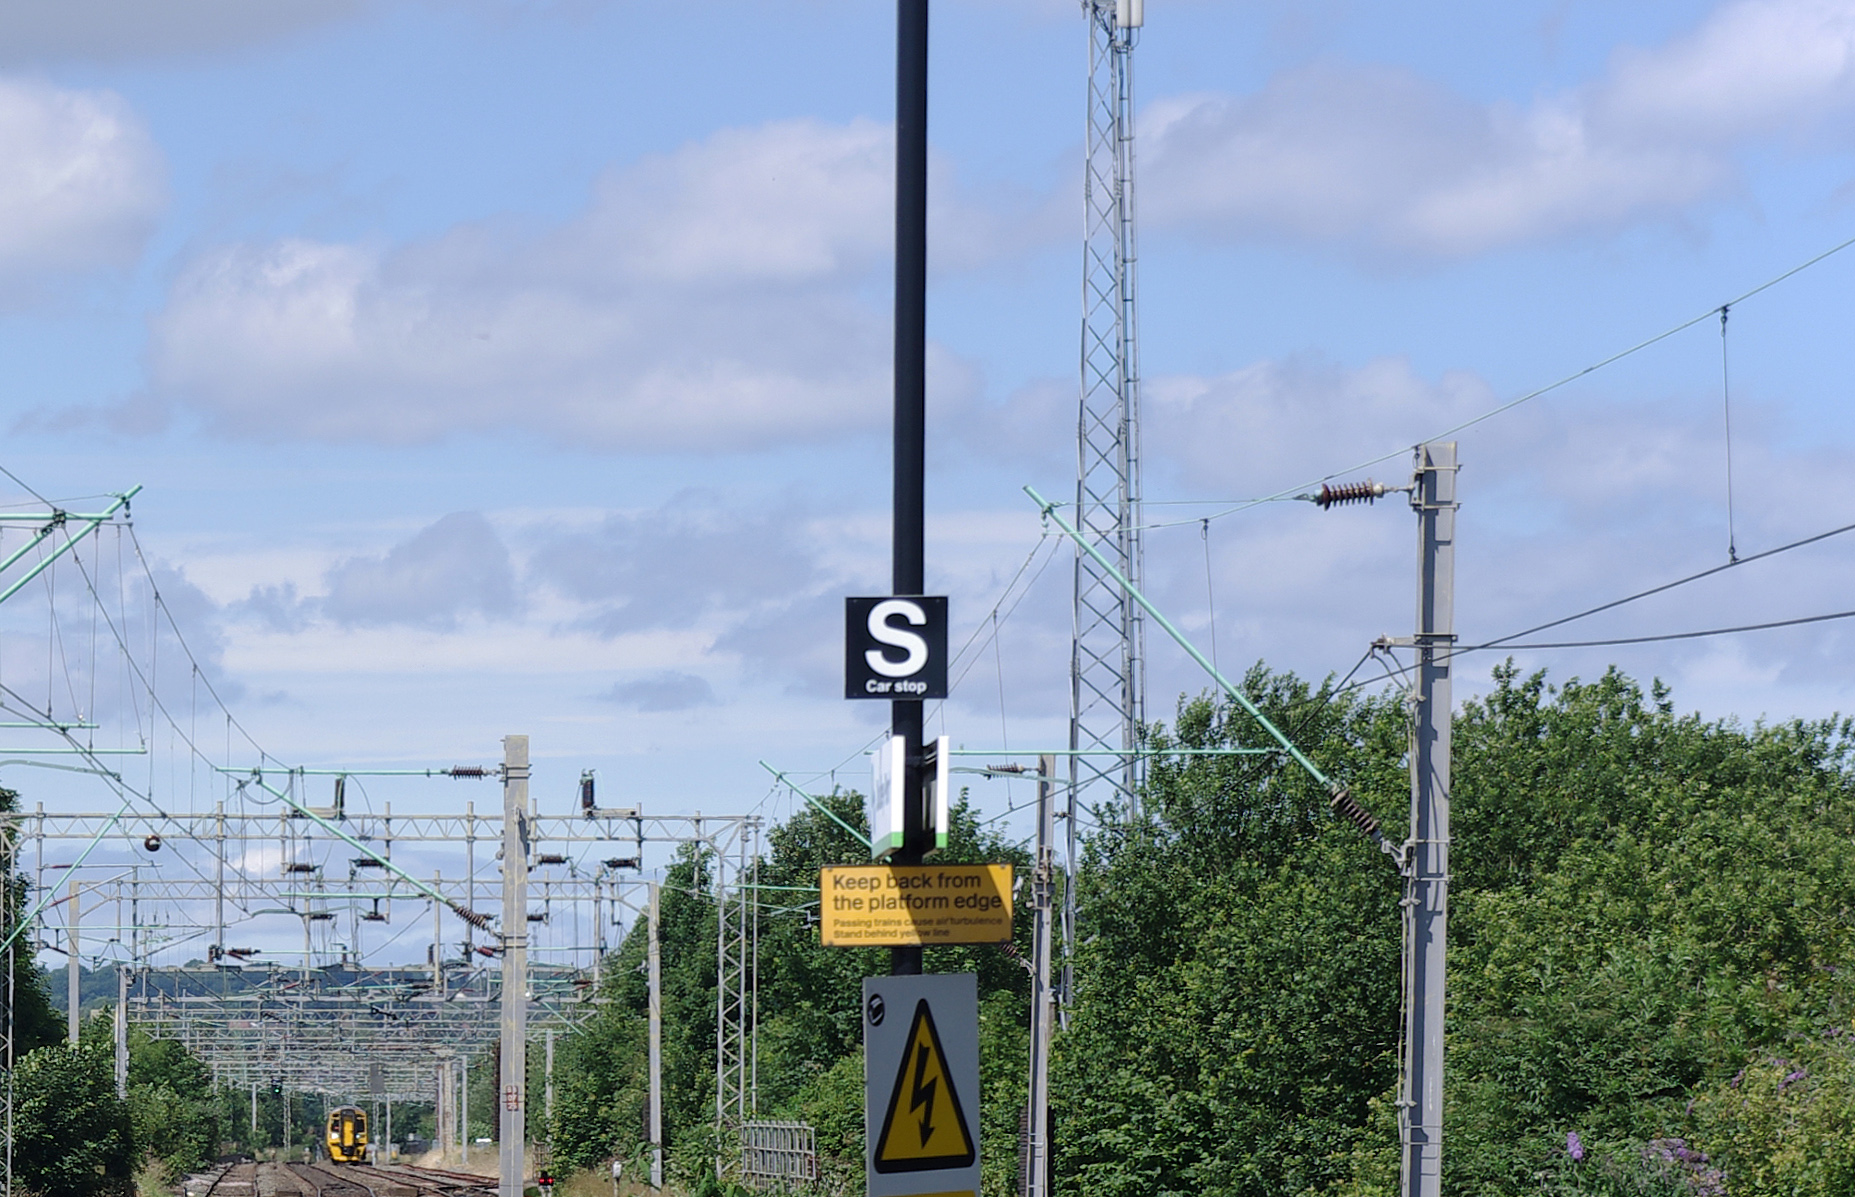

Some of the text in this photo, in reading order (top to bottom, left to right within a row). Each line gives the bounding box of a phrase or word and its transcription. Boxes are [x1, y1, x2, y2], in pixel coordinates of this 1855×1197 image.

[864, 599, 929, 678] S
[865, 679, 927, 695] Car stop
[833, 873, 981, 893] Keep back from
[833, 893, 1002, 913] the platform edge
[833, 919, 872, 929] Passing
[874, 918, 902, 927] trains
[950, 917, 1002, 926] turbulence
[834, 928, 950, 940] Stand behind yellow line
